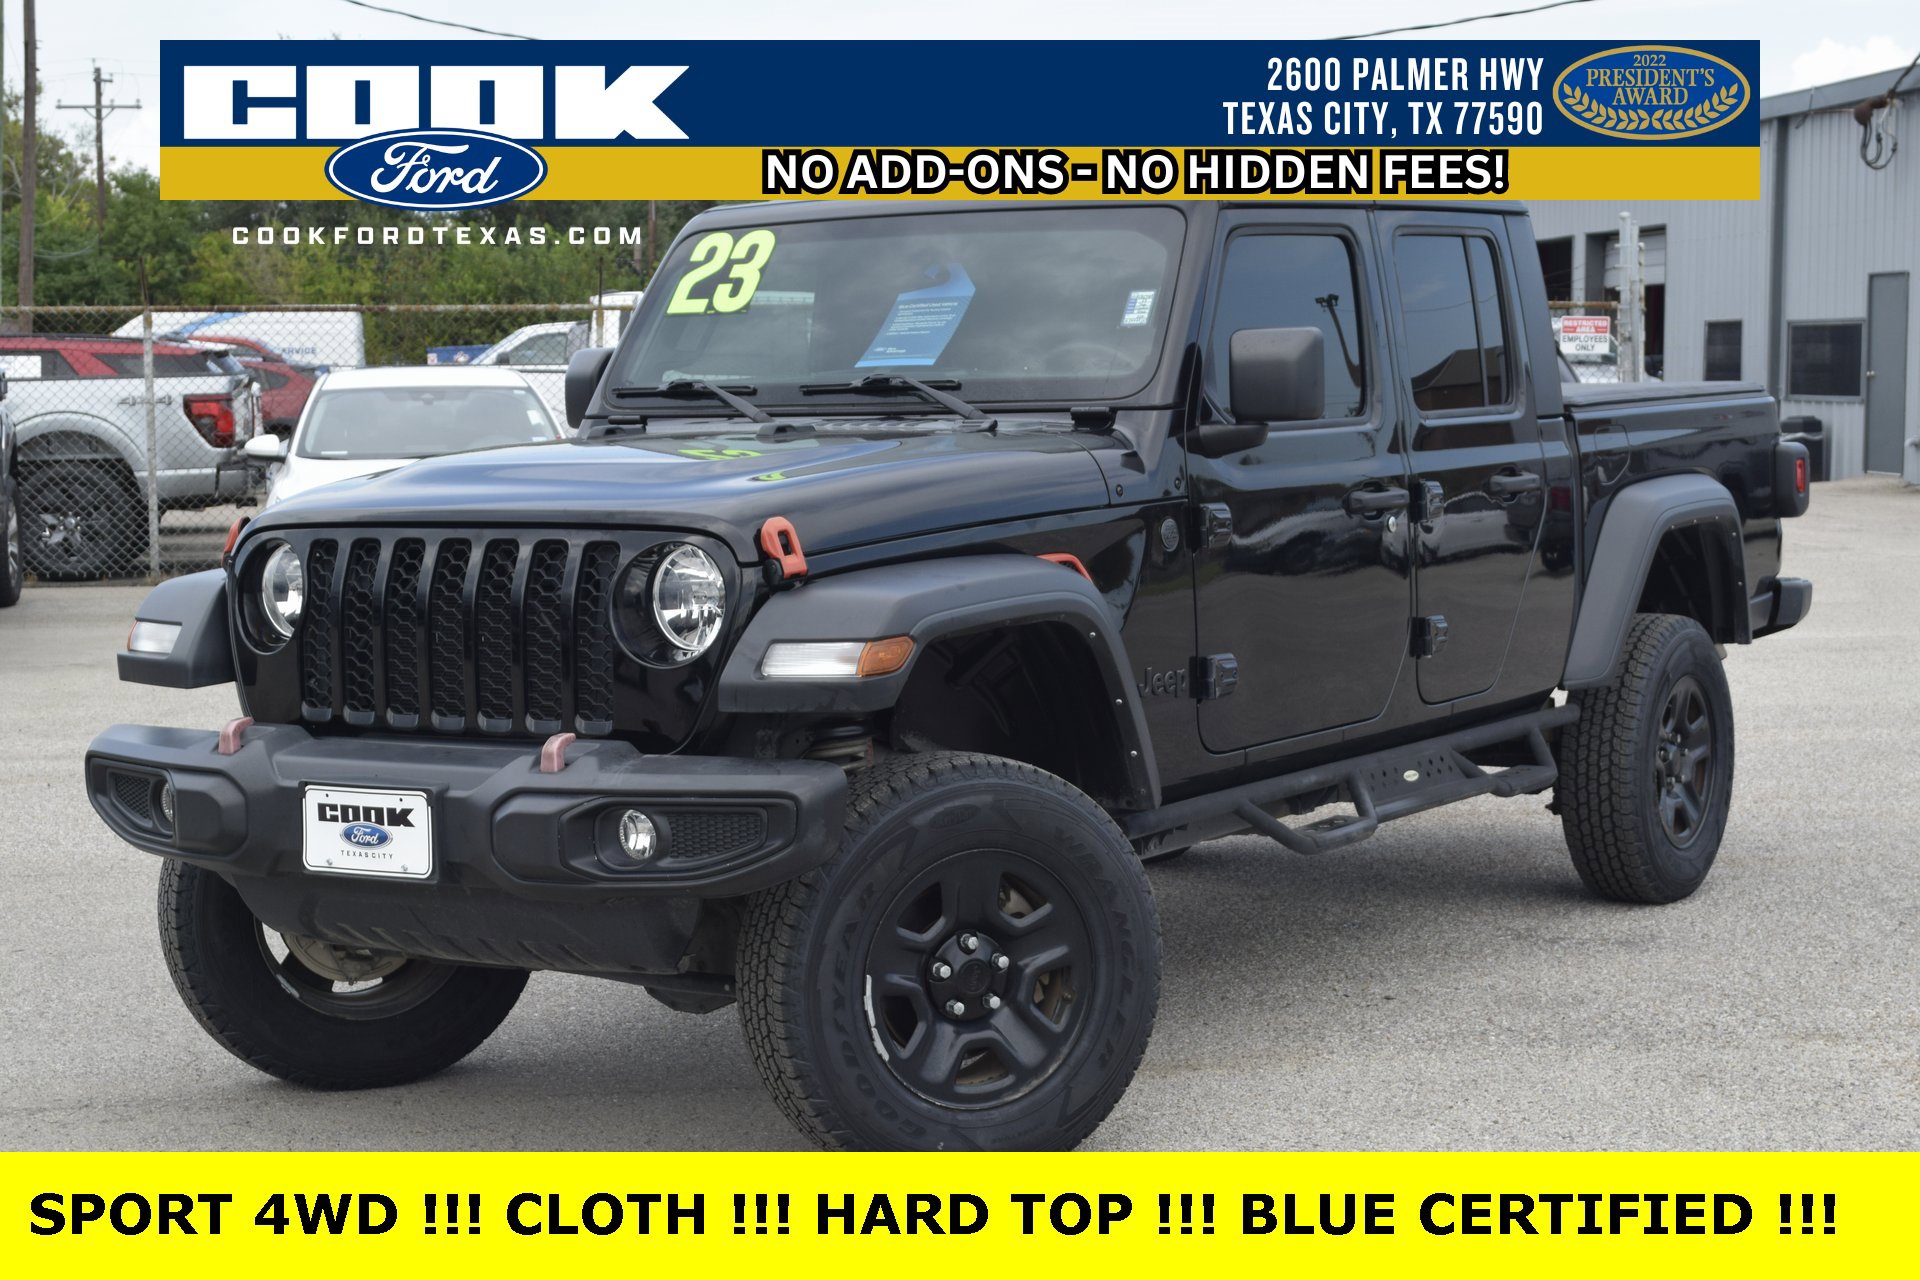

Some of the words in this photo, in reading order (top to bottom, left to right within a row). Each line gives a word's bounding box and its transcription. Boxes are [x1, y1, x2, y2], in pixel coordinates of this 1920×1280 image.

[666, 229, 775, 314] 23
[1563, 319, 1608, 327] RESTRICTED
[1562, 334, 1608, 343] EMPLOYEES
[1575, 343, 1595, 351] ONLY
[1137, 667, 1188, 698] Jeep
[317, 802, 416, 828] COOK
[351, 826, 380, 845] Ford
